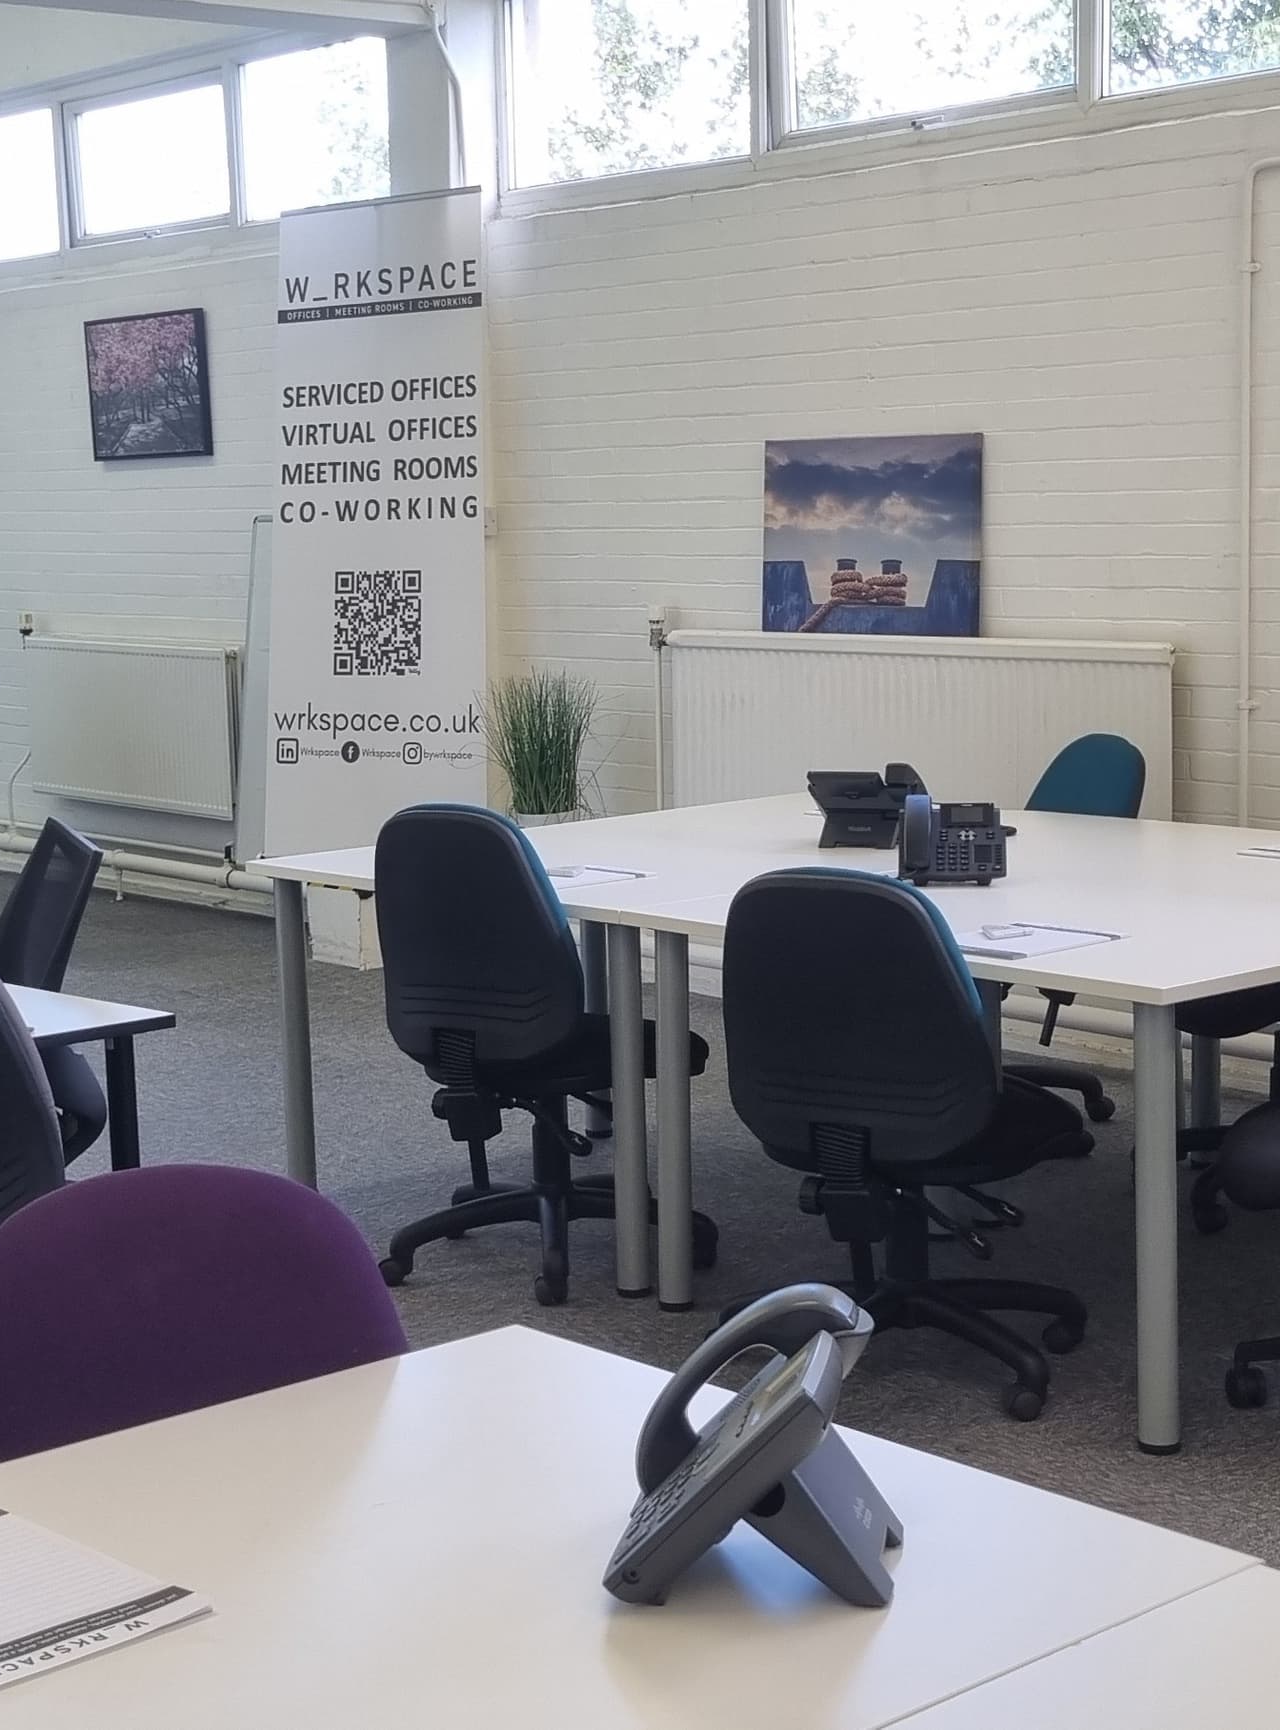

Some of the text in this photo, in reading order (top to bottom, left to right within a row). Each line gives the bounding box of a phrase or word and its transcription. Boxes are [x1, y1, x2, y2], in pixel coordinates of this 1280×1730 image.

[286, 260, 476, 303] W_RKSPACE
[287, 296, 472, 321] OFFICES MEETING ROOMS CO-WORKING
[282, 374, 476, 408] SERVICED OFFICES
[282, 415, 477, 446] VIRTUAL OFFICES
[281, 455, 477, 485] MEETING ROOMS
[280, 495, 478, 523] CO-WORKING
[274, 702, 480, 740] wrkspace.co.uk
[423, 749, 473, 761] bywrkspace
